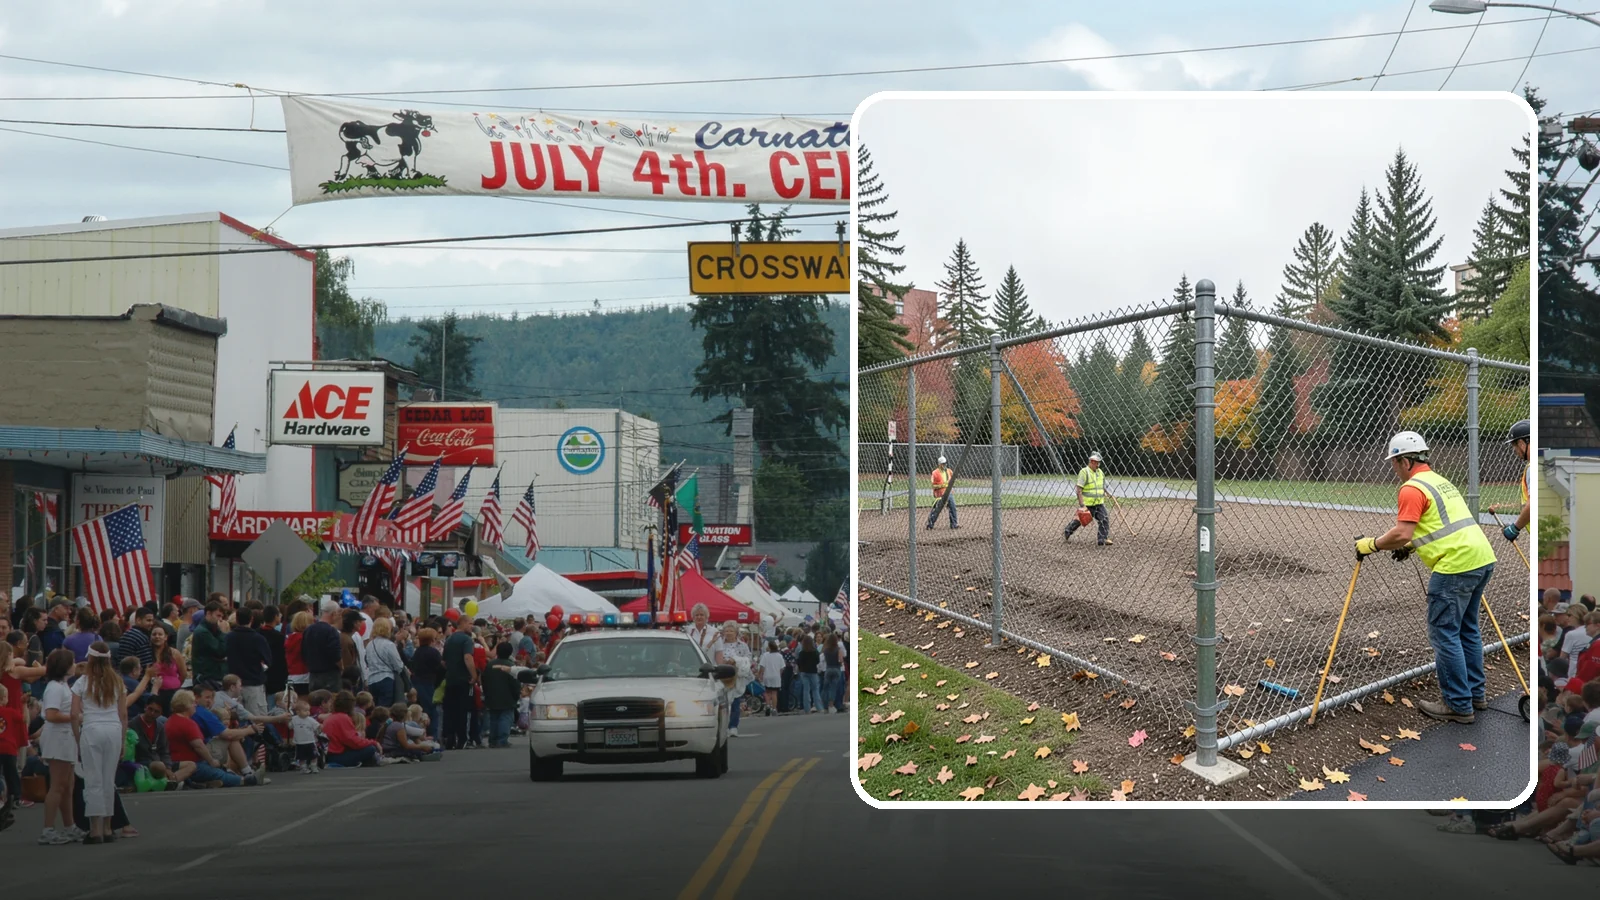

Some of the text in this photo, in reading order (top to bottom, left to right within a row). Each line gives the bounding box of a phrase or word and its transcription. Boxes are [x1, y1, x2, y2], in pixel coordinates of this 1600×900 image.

[481, 141, 605, 193] JULY
[632, 150, 746, 198] 4th.
[697, 254, 850, 280] CROSSWA
[283, 380, 374, 420] ACE
[406, 410, 452, 422] CEDAR
[283, 421, 371, 437] Hardware
[416, 428, 477, 447] Coca-Cola
[353, 467, 385, 481] Simpl
[95, 485, 124, 495] Vincent
[126, 486, 136, 495] de
[138, 486, 155, 495] Paul
[212, 516, 331, 536] HARDARE
[688, 526, 741, 535] CRNATION
[699, 535, 730, 543] GLASS
